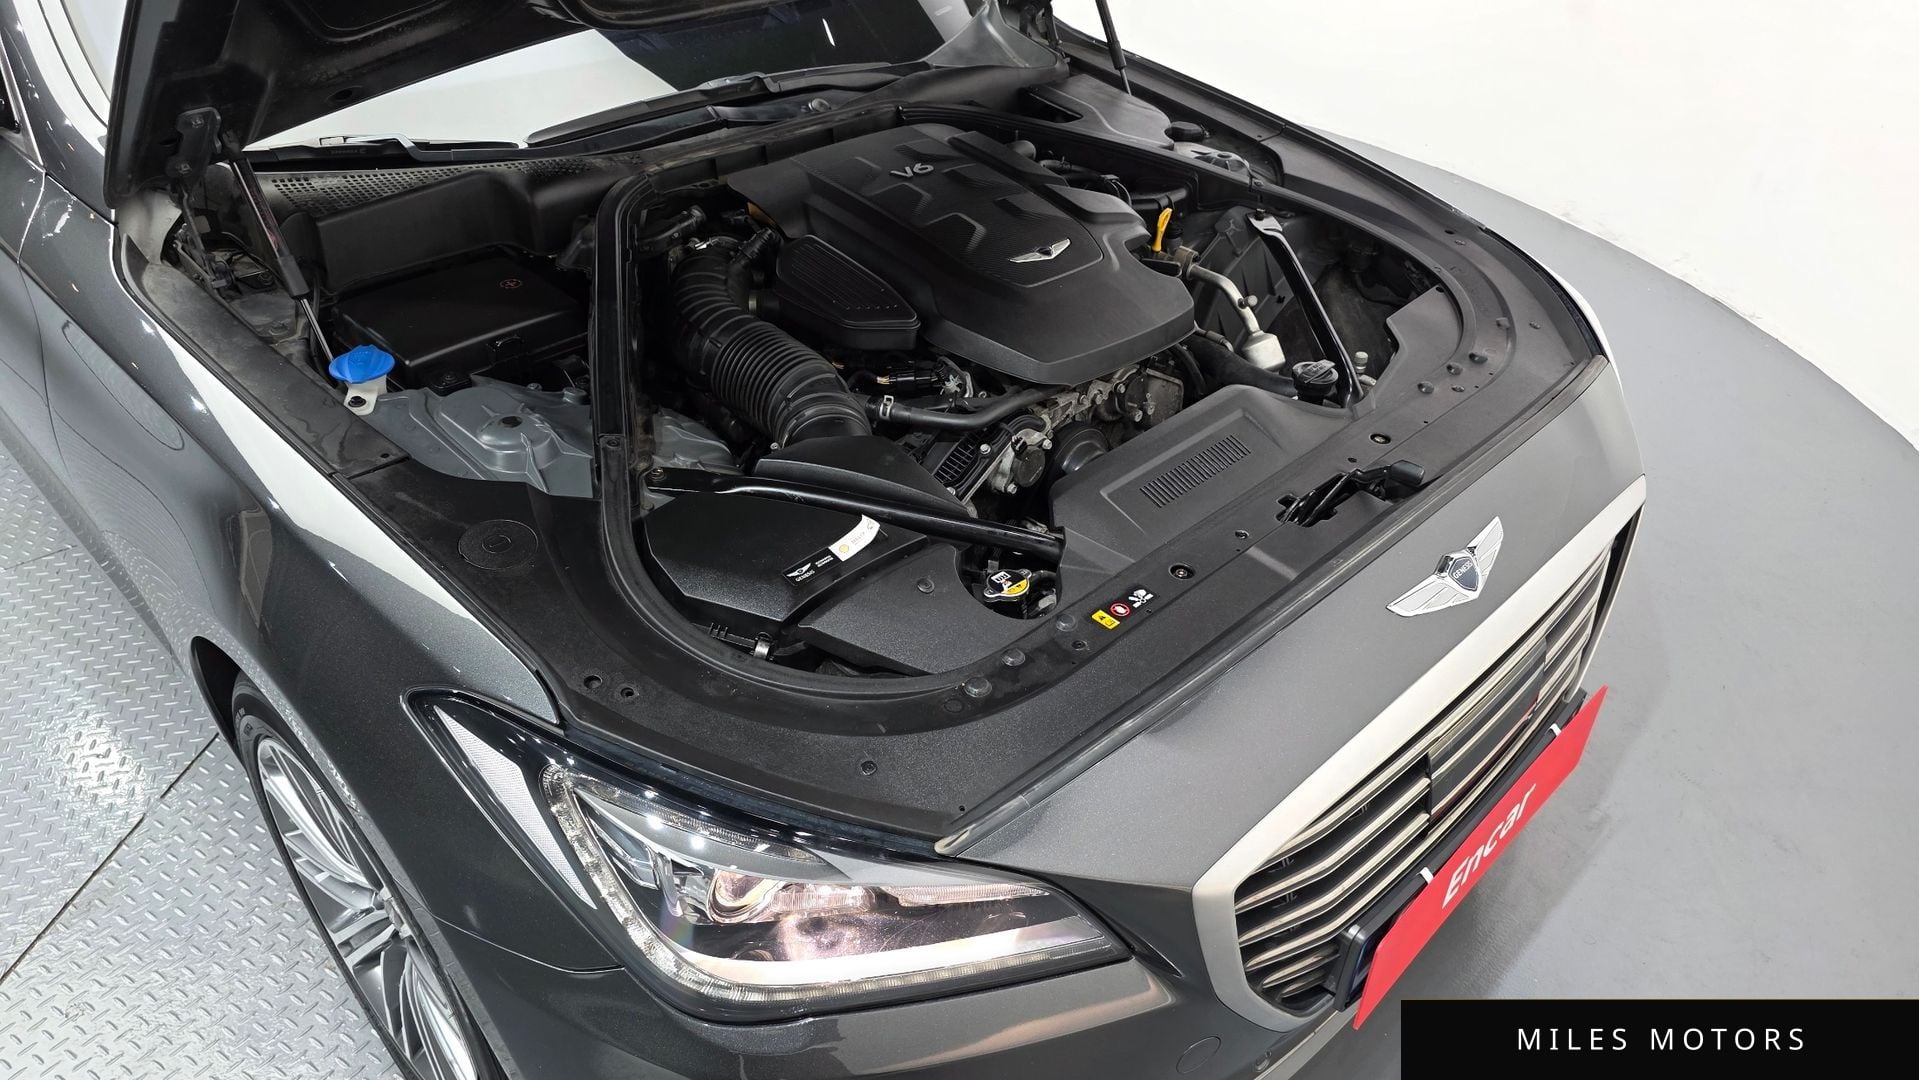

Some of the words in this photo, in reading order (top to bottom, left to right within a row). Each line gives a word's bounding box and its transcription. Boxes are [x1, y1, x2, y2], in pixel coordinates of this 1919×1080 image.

[890, 162, 934, 178] V6
[1452, 560, 1474, 579] GENESIS
[1441, 783, 1537, 909] Encar
